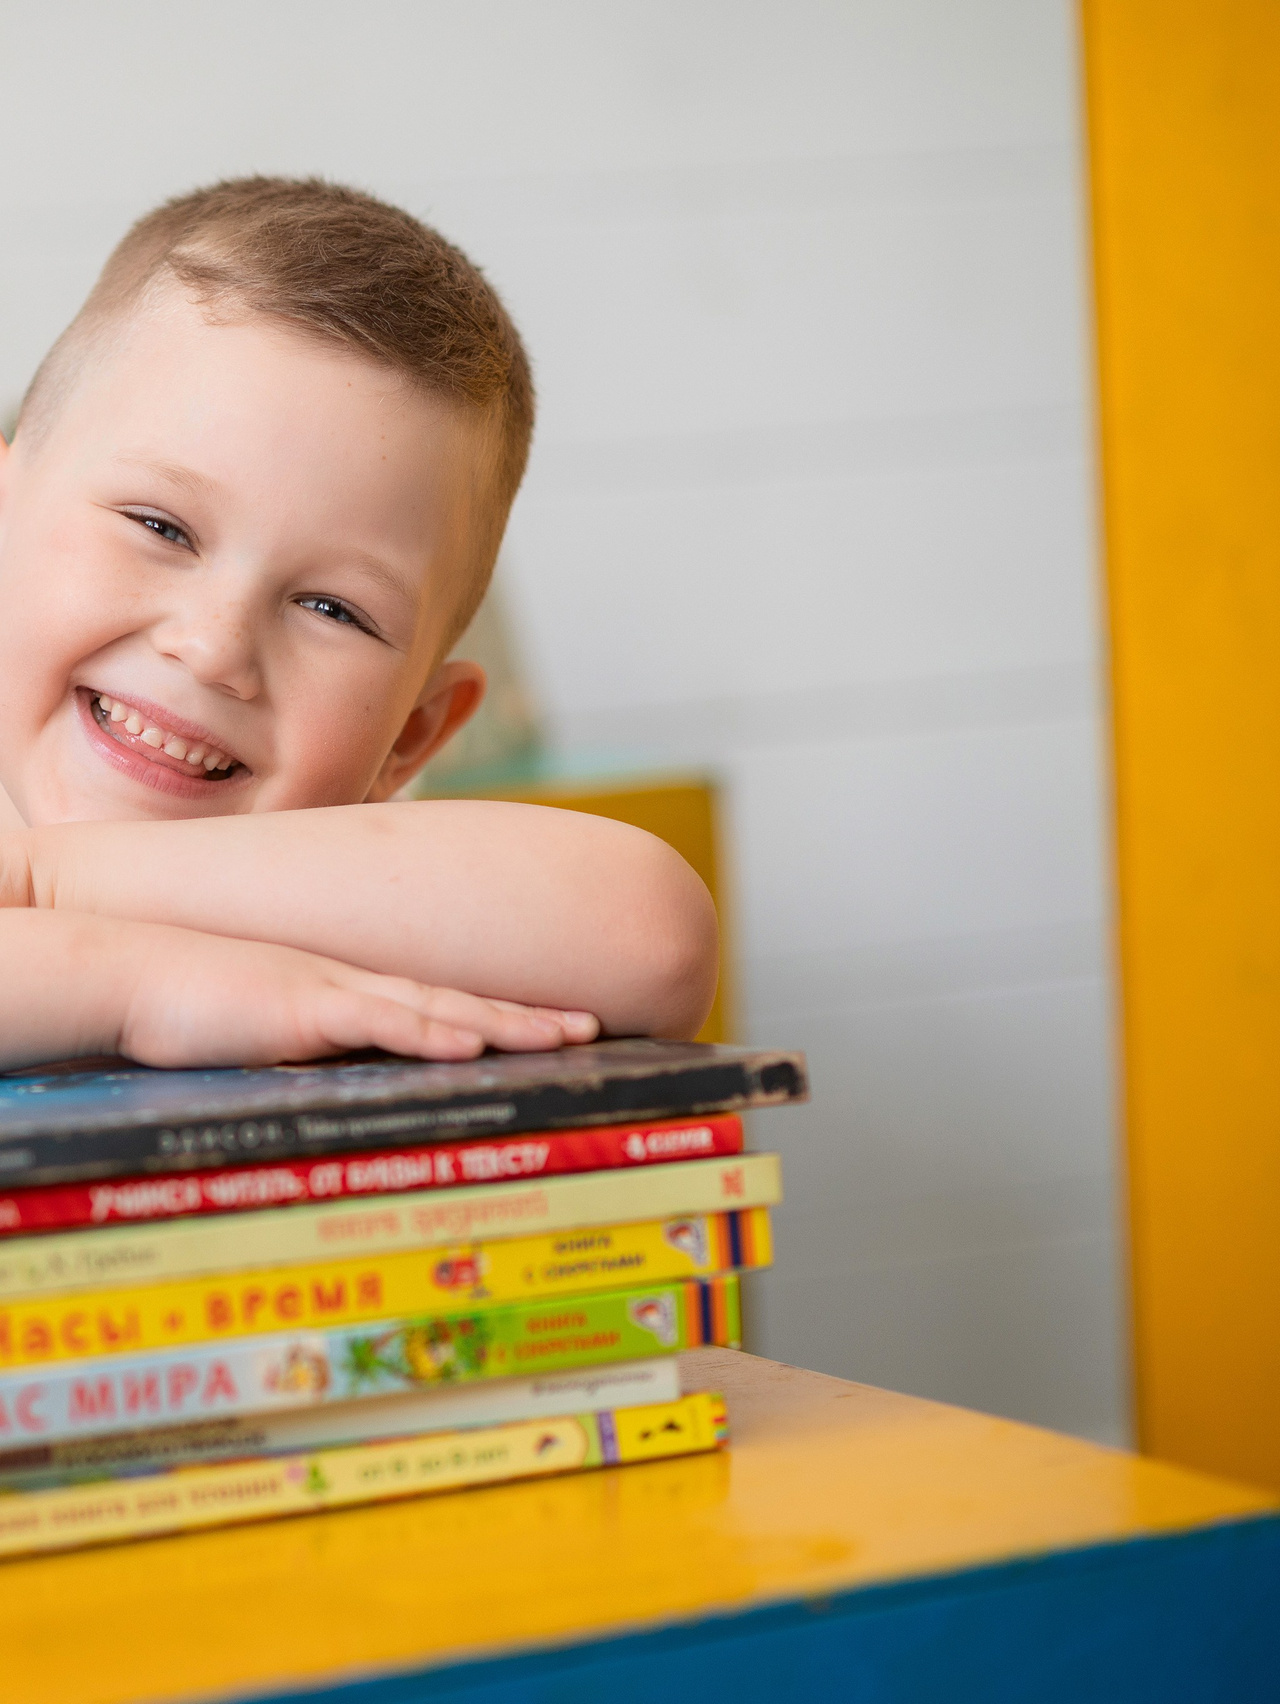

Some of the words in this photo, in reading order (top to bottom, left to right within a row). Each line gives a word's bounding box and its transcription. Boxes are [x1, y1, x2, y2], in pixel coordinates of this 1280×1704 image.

[89, 1177, 202, 1223] УЧИМСЯ
[309, 1162, 343, 1197] ОТ
[346, 1154, 432, 1191] БУКВЫ
[433, 1151, 456, 1183] К
[459, 1141, 550, 1181] ТЕКСТУ
[553, 1235, 613, 1255] КНИГА
[526, 1311, 588, 1335] КНИГА
[72, 1361, 238, 1420] МИРА
